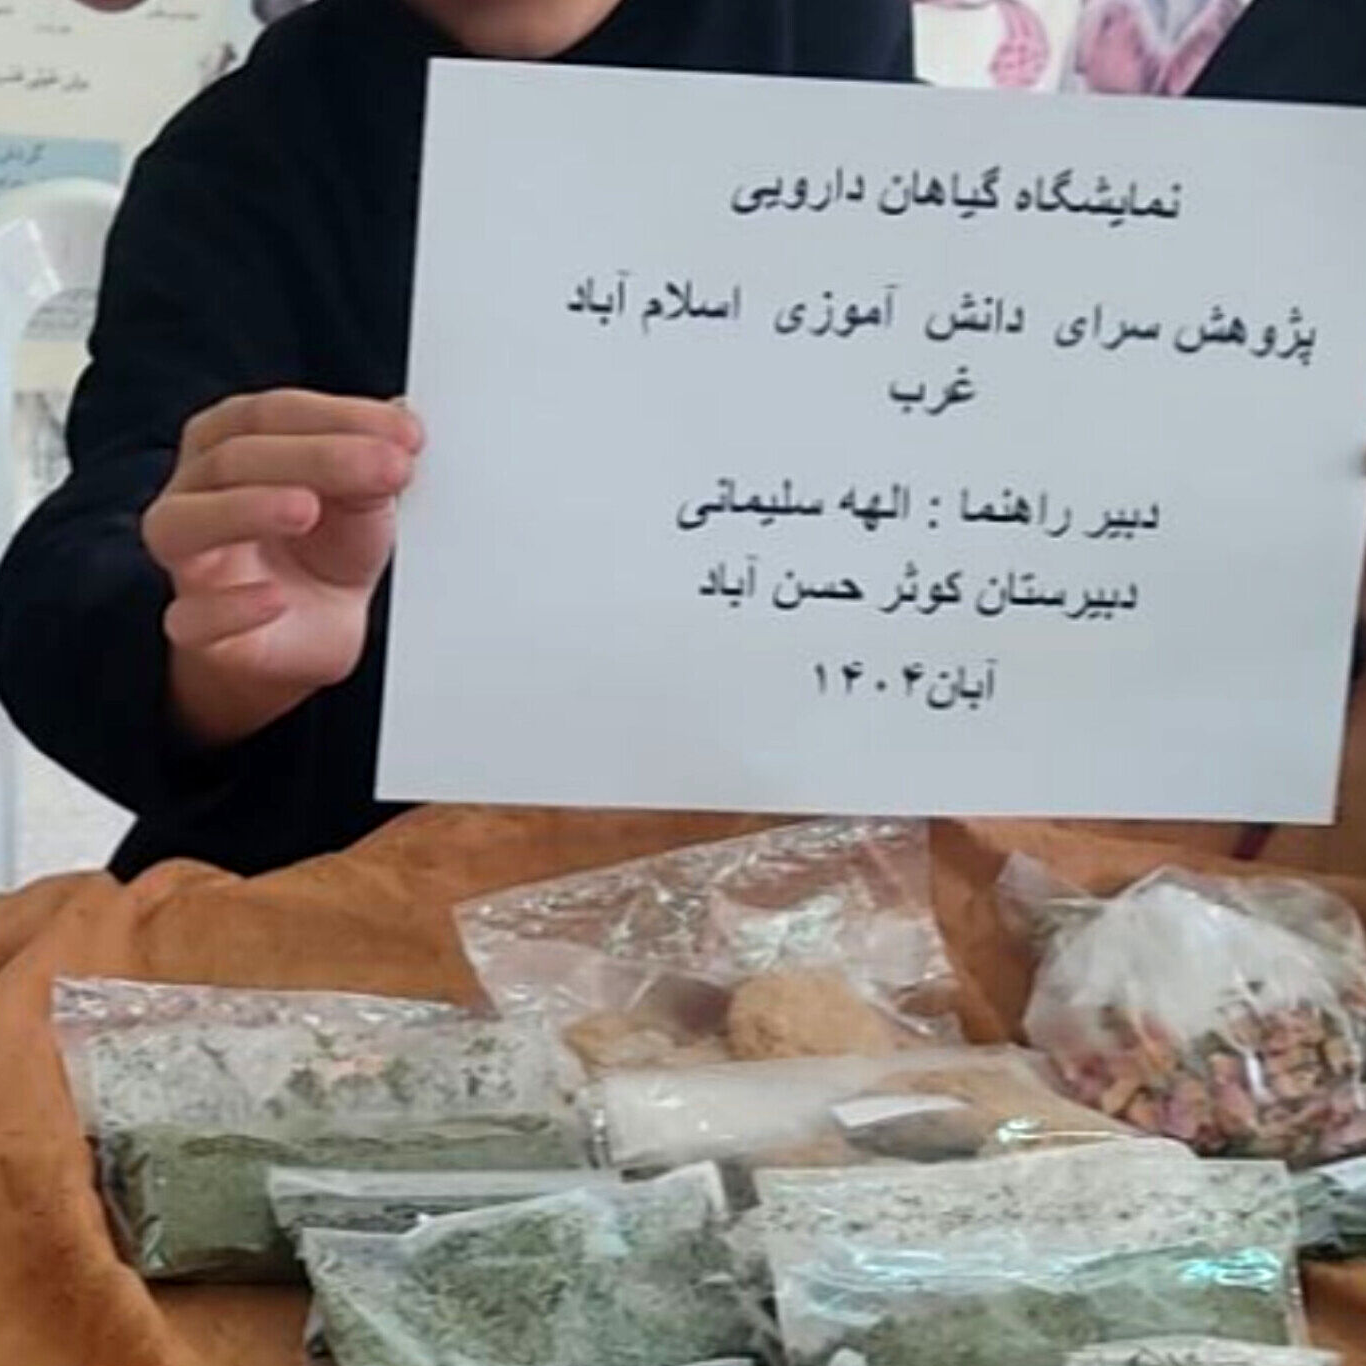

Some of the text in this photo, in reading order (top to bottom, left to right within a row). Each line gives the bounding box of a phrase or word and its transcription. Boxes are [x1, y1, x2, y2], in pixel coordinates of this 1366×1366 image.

[730, 165, 1183, 229] نمایشگاه گیاهان دارویی
[566, 270, 1317, 367] پژوهش سرای دانش آموزی اسلام آباد
[888, 365, 976, 417] غرب
[675, 477, 825, 532] سلیمانی
[837, 483, 911, 533] الهه
[960, 488, 1072, 538] راهنما
[1083, 503, 1160, 540] دبیر
[698, 555, 1139, 621] دبیرستان کوثر حسن آباد
